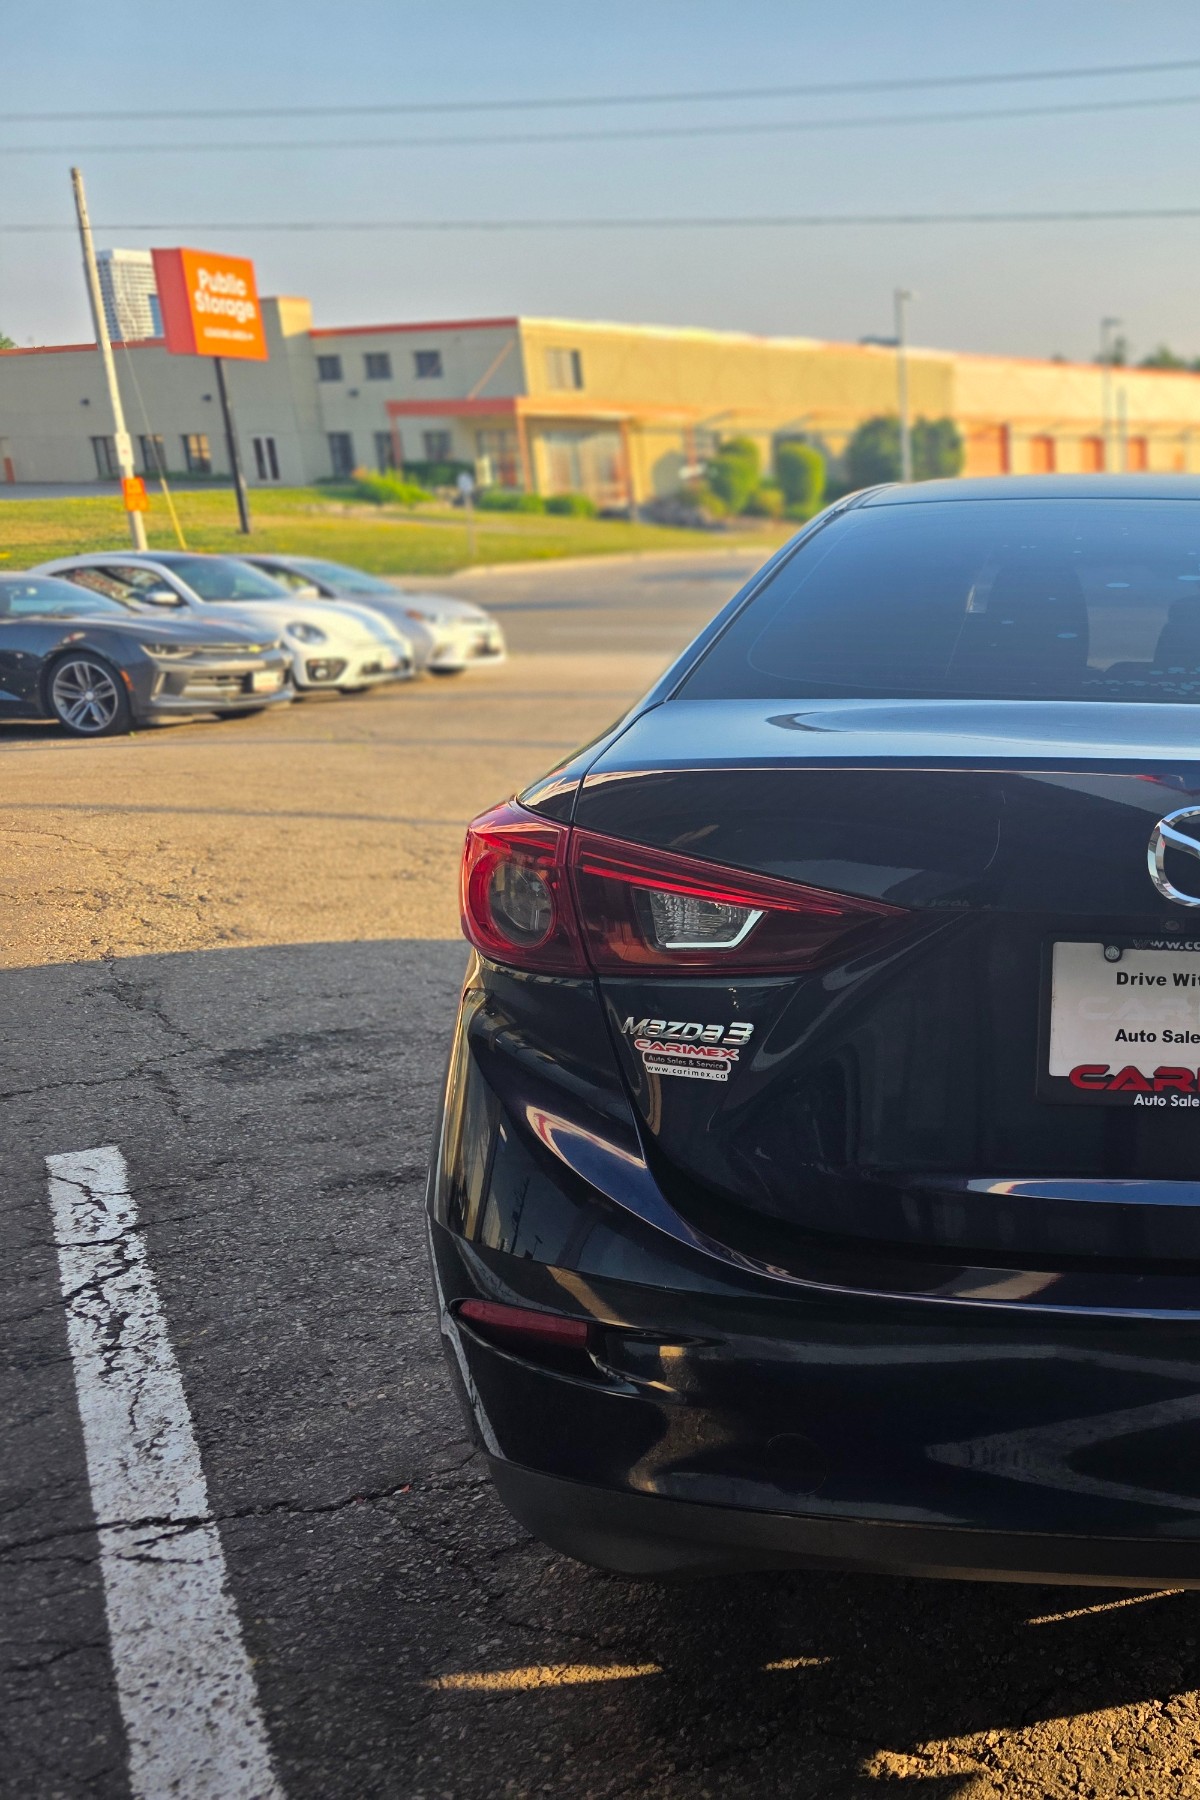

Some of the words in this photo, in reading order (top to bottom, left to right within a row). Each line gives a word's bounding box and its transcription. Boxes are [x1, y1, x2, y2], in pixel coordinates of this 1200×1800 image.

[197, 268, 247, 297] Public
[194, 290, 256, 323] Storage
[1116, 972, 1167, 986] Drive
[1115, 1029, 1157, 1043] Auto
[635, 1040, 738, 1060] CARIMEX
[648, 1055, 665, 1063] Auto
[667, 1058, 687, 1067] Sales
[696, 1061, 725, 1070] Service
[647, 1065, 726, 1079] www.carimex.ca
[1133, 1094, 1166, 1107] Auto
